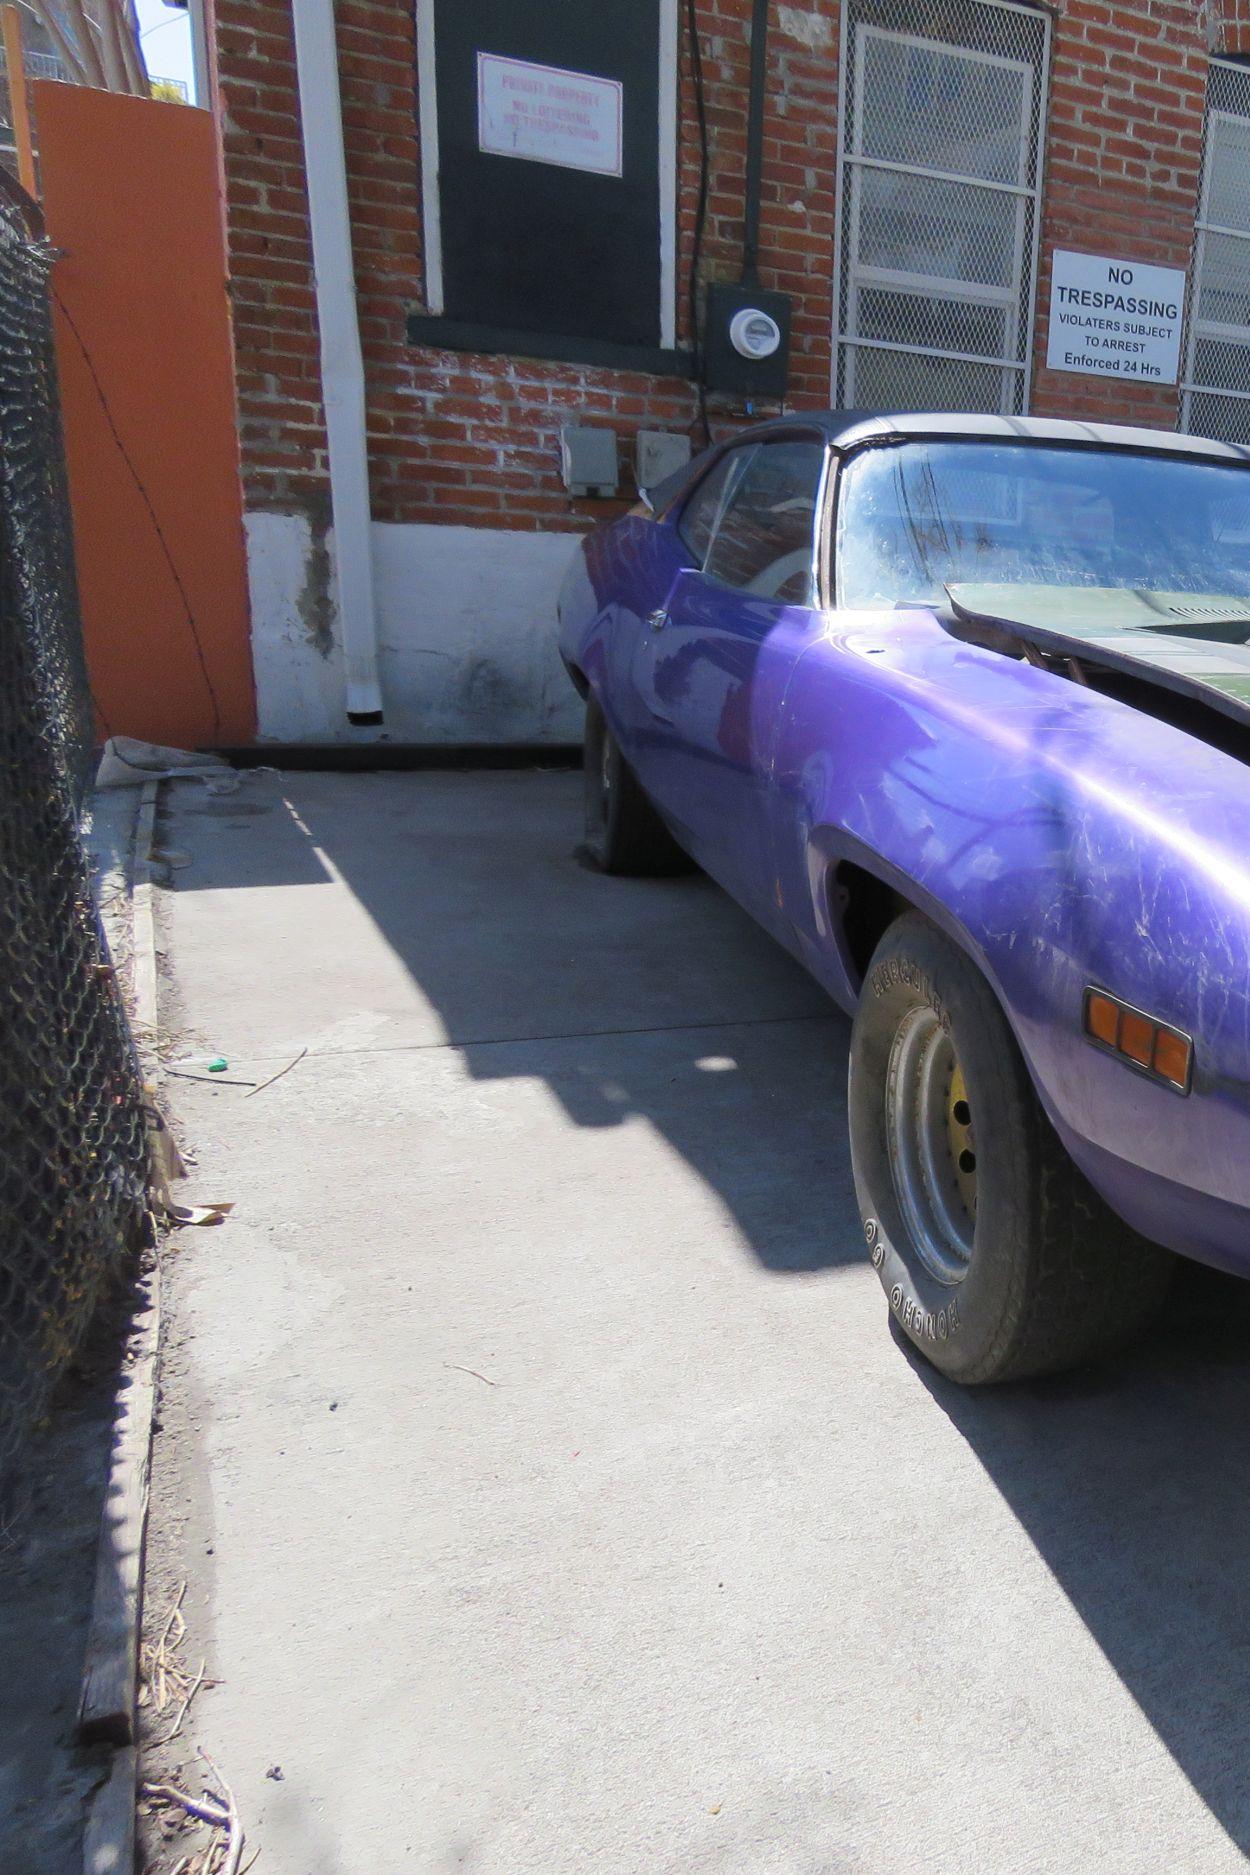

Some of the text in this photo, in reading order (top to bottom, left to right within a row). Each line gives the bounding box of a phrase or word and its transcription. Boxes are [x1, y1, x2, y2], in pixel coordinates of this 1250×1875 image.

[1108, 267, 1134, 286] NO
[1057, 286, 1178, 320] TRESPASSING
[1059, 313, 1173, 339] VIOLATERS SUBJECT
[1085, 335, 1146, 354] TO ARREST
[1064, 352, 1161, 376] Enforced 24 Hrs
[890, 1282, 961, 1341] HONCHO
